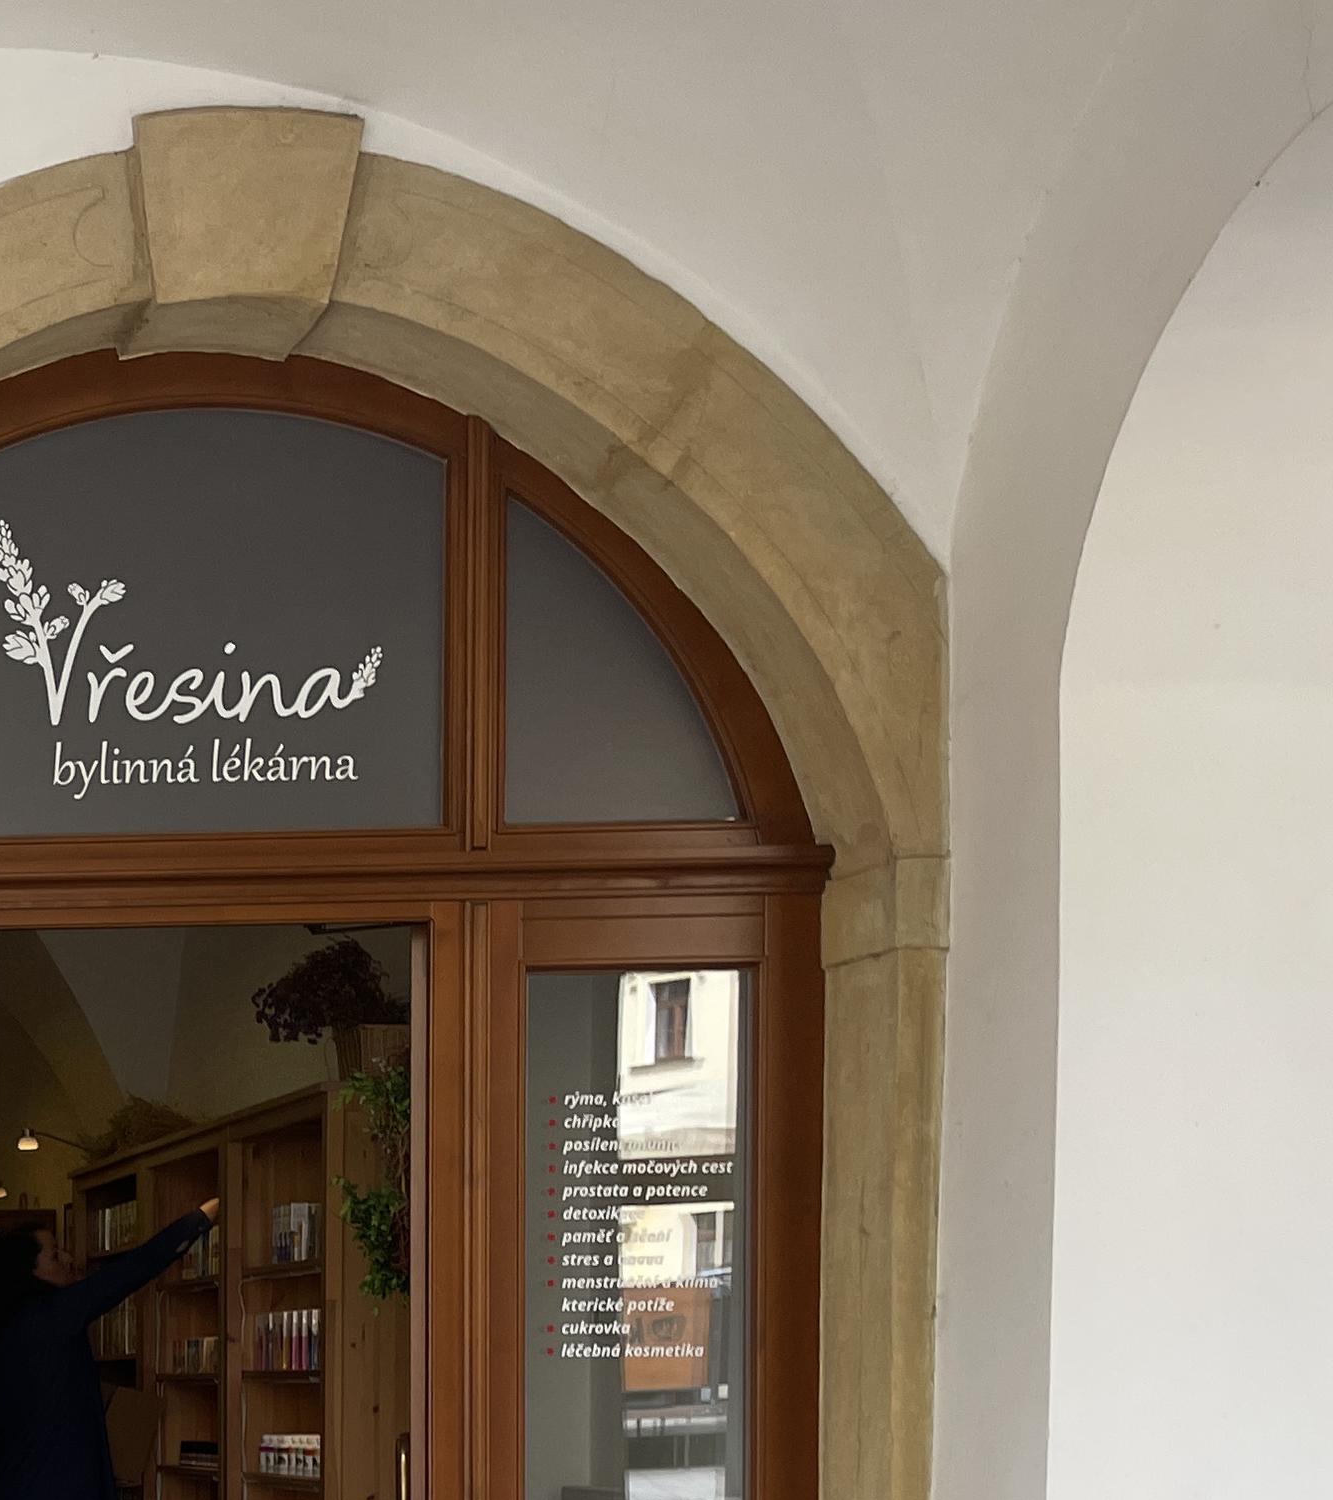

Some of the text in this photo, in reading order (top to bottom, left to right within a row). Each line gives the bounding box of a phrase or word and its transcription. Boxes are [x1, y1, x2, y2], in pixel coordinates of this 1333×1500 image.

[52, 738, 359, 800] bylinná lékárna
[563, 1091, 608, 1109] rýma,
[562, 1159, 734, 1178] infekce močových cest
[562, 1183, 709, 1201] prostata a potence
[562, 1229, 614, 1247] paměť
[562, 1253, 599, 1266] stres
[603, 1254, 614, 1266] a
[561, 1296, 675, 1315] kterické potíže
[561, 1320, 631, 1336] cukrovka
[561, 1342, 704, 1358] léčebná kosmetika
